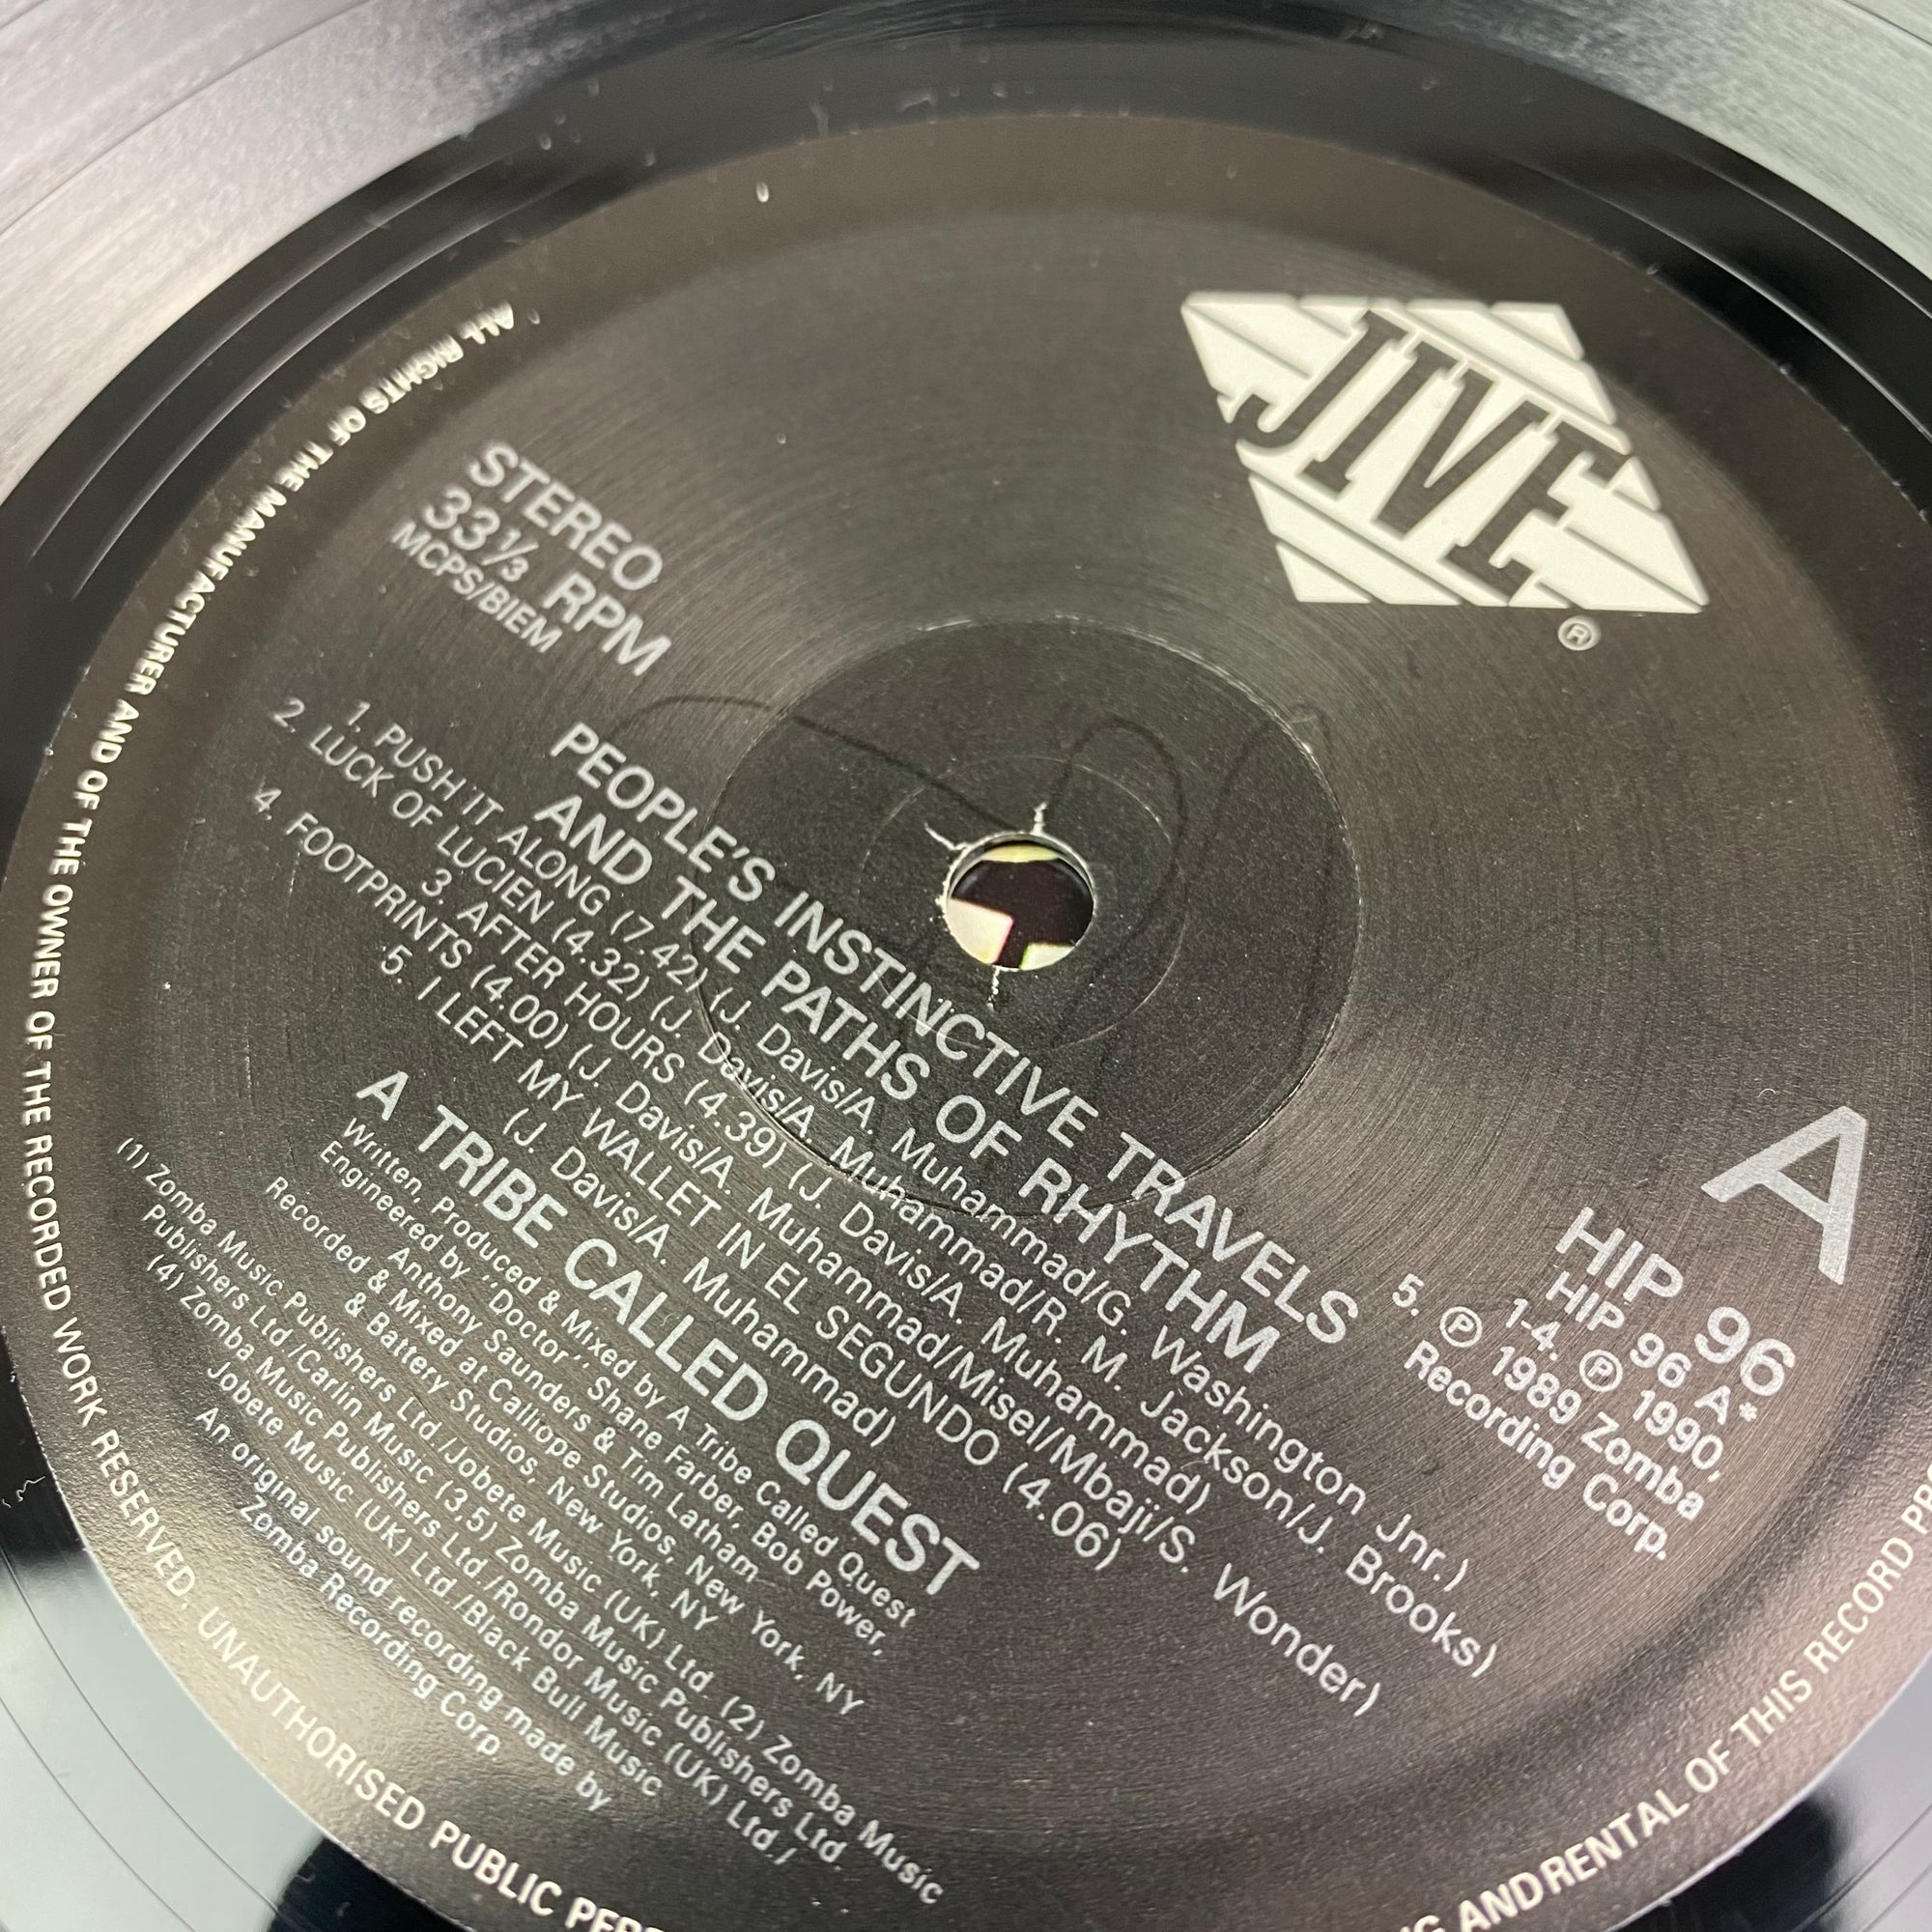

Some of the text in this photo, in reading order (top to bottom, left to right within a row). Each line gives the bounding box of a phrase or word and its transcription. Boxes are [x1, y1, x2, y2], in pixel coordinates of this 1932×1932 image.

[392, 522, 562, 653] MCPS/BIEM
[468, 443, 663, 590] STEREO
[541, 571, 670, 675] RPM
[1231, 306, 1634, 608] JIVE
[20, 304, 561, 1916] ALL RIGHTS OF THE MANUFACTURER AND OF THE OWNER OF THE RECORDED WORK RESERVED. UNAUTHORISED PUBLIC
[254, 788, 1380, 1717] 4. FOOTPRINTS (4.00) (J. Davis/A. Muhammad/Misel/Mbaji/S. Wonder)
[273, 698, 1496, 1677] 2. LUCK OF LUCIEN (4.32) (J. Davis/A. Muhammad/R. M. Jackson/J. Brooks)
[348, 702, 1468, 1591] 1. PUSH IT ALONG (7.42) (J. Davis/A. Muhammad/G. Washington Jnr.)
[380, 944, 1121, 1571] 5. I LEFT MY WALLET IN EL SEGUNDO (4.06)
[420, 867, 1210, 1514] 3. AFTER HOURS (4.39) (J. Davis/A. Muhammad)
[502, 1107, 895, 1447] (J. Davis/A. Muhammad)
[533, 795, 1280, 1373] AND THE PATHS OF RHYTHM
[773, 891, 1098, 1149] INSTINCTIVE
[1106, 1131, 1358, 1343] TRAVELS
[1703, 1106, 1867, 1284] A
[264, 1176, 865, 1715] Recorded & Mixed at Calliope Studios, New York, NY
[319, 1140, 886, 1656] Engineered by Shane Farber, Bob Power,
[341, 1117, 916, 1628] Written, Produced & Mixed by A Tribe Called Quest
[355, 1070, 980, 1595] A TRIBE CALLED QUEST
[386, 1246, 758, 1582] Anthony Saunders & Tim Latham
[1391, 1272, 1704, 1520] 5. 1989 Zomba
[1403, 1339, 1667, 1560] Recording Corp.
[1504, 1297, 1723, 1482] 1-4. 1990,
[1545, 1269, 1692, 1388] HIP 96
[1554, 1206, 1795, 1396] HIP 96
[116, 1136, 943, 1904] (1) Zomba Music Publishers Ltd./Jobete Music (UK) Ltd. (2) Zomba Music
[146, 1253, 797, 1864] (4) Zomba Music Publishers Ltd./Rondor Music (UK) Ltd./
[193, 1406, 611, 1811] An original sound recording made by
[1685, 1738, 1729, 1793] OF
[1729, 1669, 1812, 1747] THIS
[1803, 1536, 1914, 1673] RECORD
